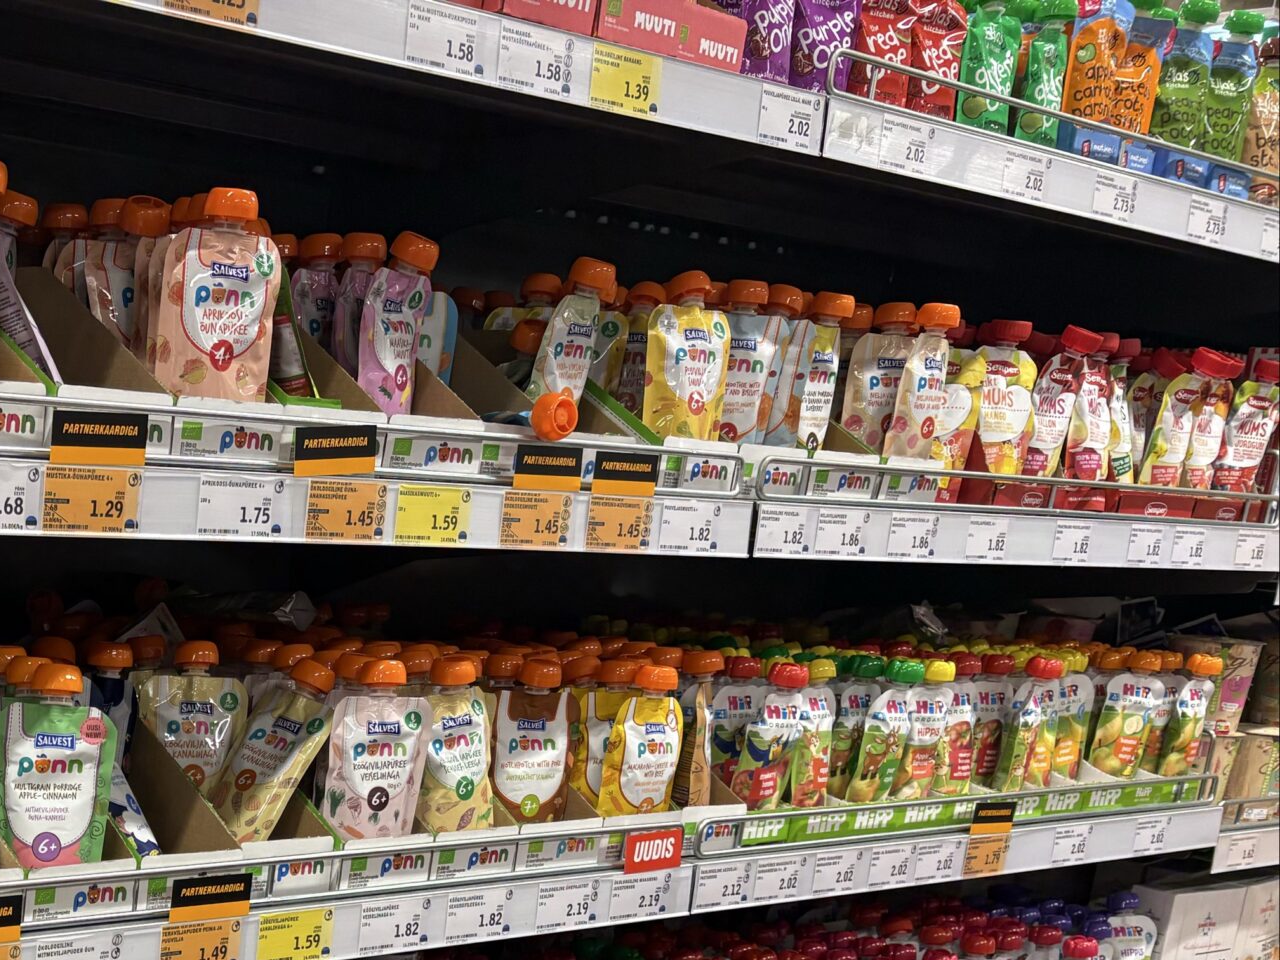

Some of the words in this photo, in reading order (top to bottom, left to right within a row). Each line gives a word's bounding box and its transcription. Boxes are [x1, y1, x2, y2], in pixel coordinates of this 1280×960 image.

[635, 12, 676, 38] MUUTI
[446, 38, 474, 61] 1.58
[700, 38, 738, 64] MUUTI
[789, 120, 809, 137] 2.02
[906, 146, 925, 163] 2.02
[212, 263, 248, 281] SALVEST
[62, 422, 138, 437] PARTNERKAARDIGA
[523, 454, 576, 468] PARTNERKAARDIGA
[90, 500, 123, 518] 1.29
[240, 507, 270, 523] 1.75
[431, 514, 457, 531] 1.59
[534, 518, 559, 535] 1.45
[689, 526, 710, 542] 1.82
[13, 783, 52, 792] MULTIGRAIN
[54, 783, 82, 792] PORRIDGE
[19, 792, 76, 800] APPLE-CINNAMON
[634, 836, 674, 862] UUDIS
[180, 882, 245, 898] PARTNERKAARDIGA
[722, 883, 742, 898] 2.12
[567, 901, 589, 917] 2.19
[394, 920, 419, 938] 1.82
[293, 934, 321, 951] 1.59
